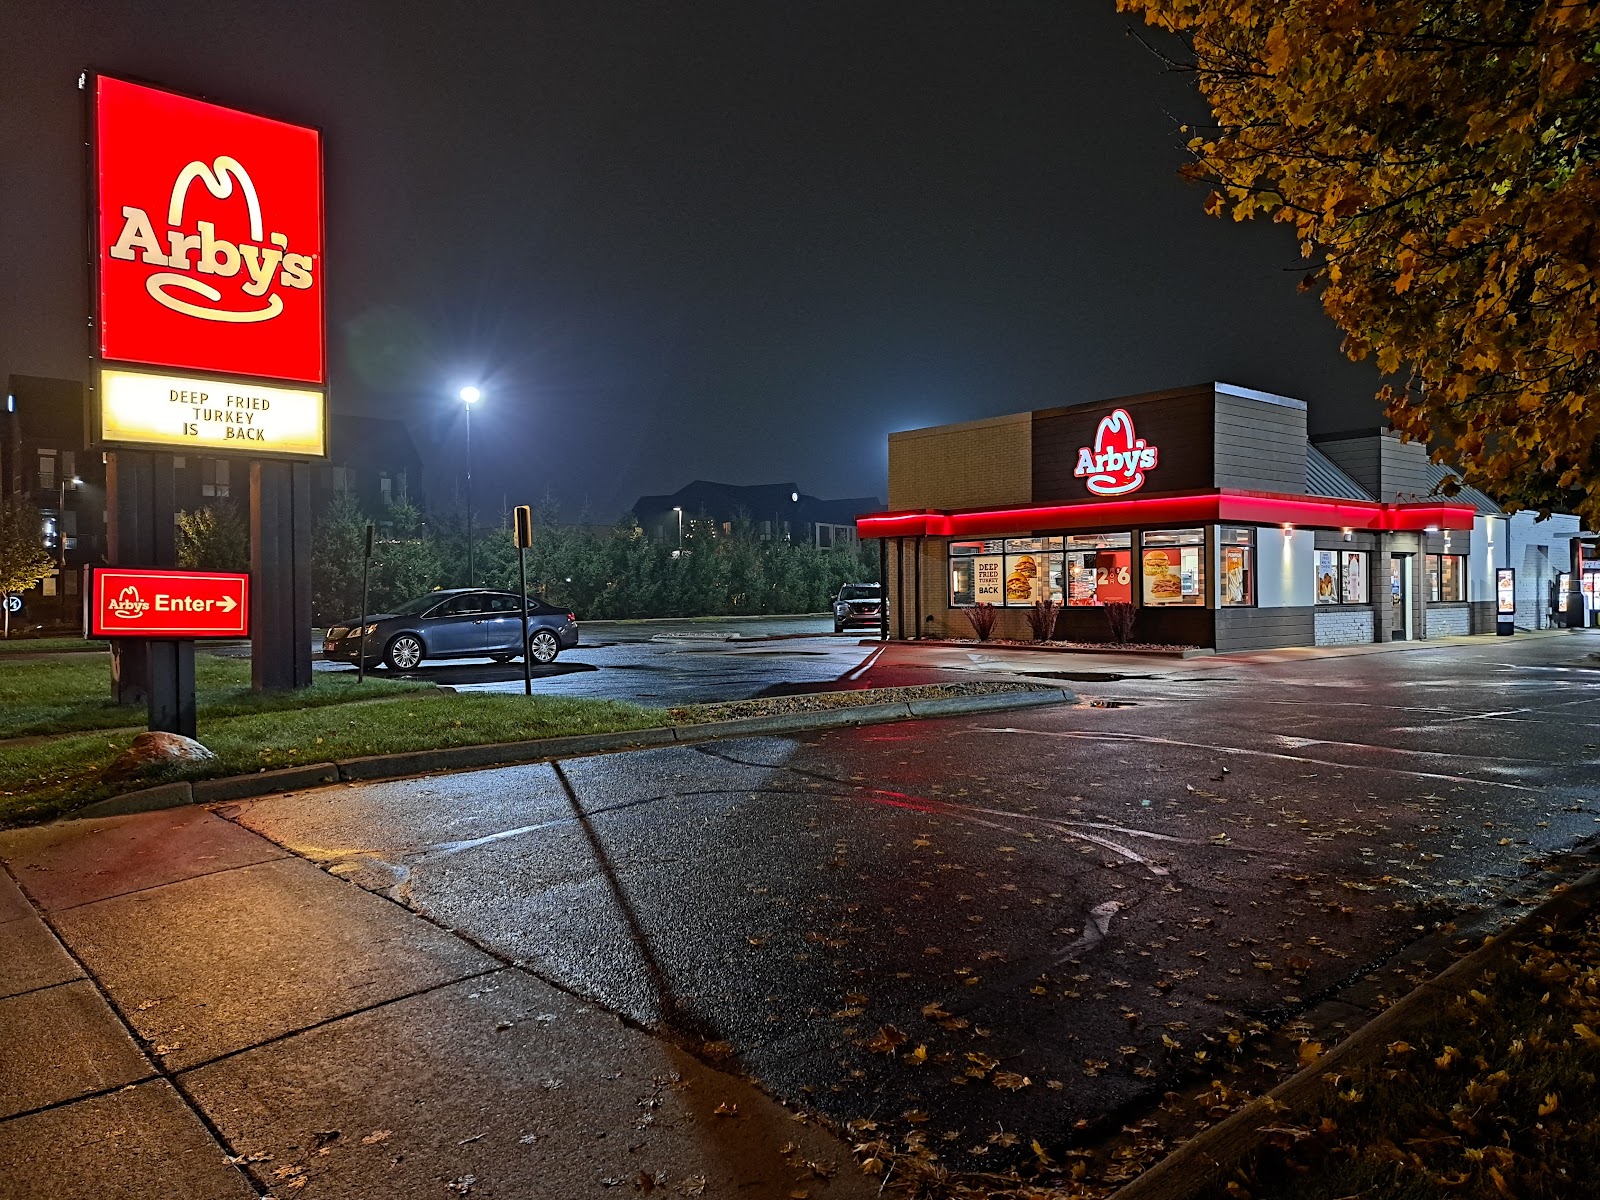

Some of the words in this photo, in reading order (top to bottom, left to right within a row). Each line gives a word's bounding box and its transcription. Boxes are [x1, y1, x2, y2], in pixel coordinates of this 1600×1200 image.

[109, 205, 314, 297] Arby's
[169, 389, 209, 405] DEEP
[227, 395, 270, 411] FRIED
[192, 407, 254, 425] TURKEY
[183, 422, 199, 436] IS
[225, 426, 265, 441] BACK
[1075, 440, 1155, 477] Arby's
[978, 563, 999, 571] DEEP
[1097, 567, 1109, 585] 2
[978, 586, 999, 594] BACK
[108, 598, 150, 613] Arby's
[155, 594, 214, 612] Enter
